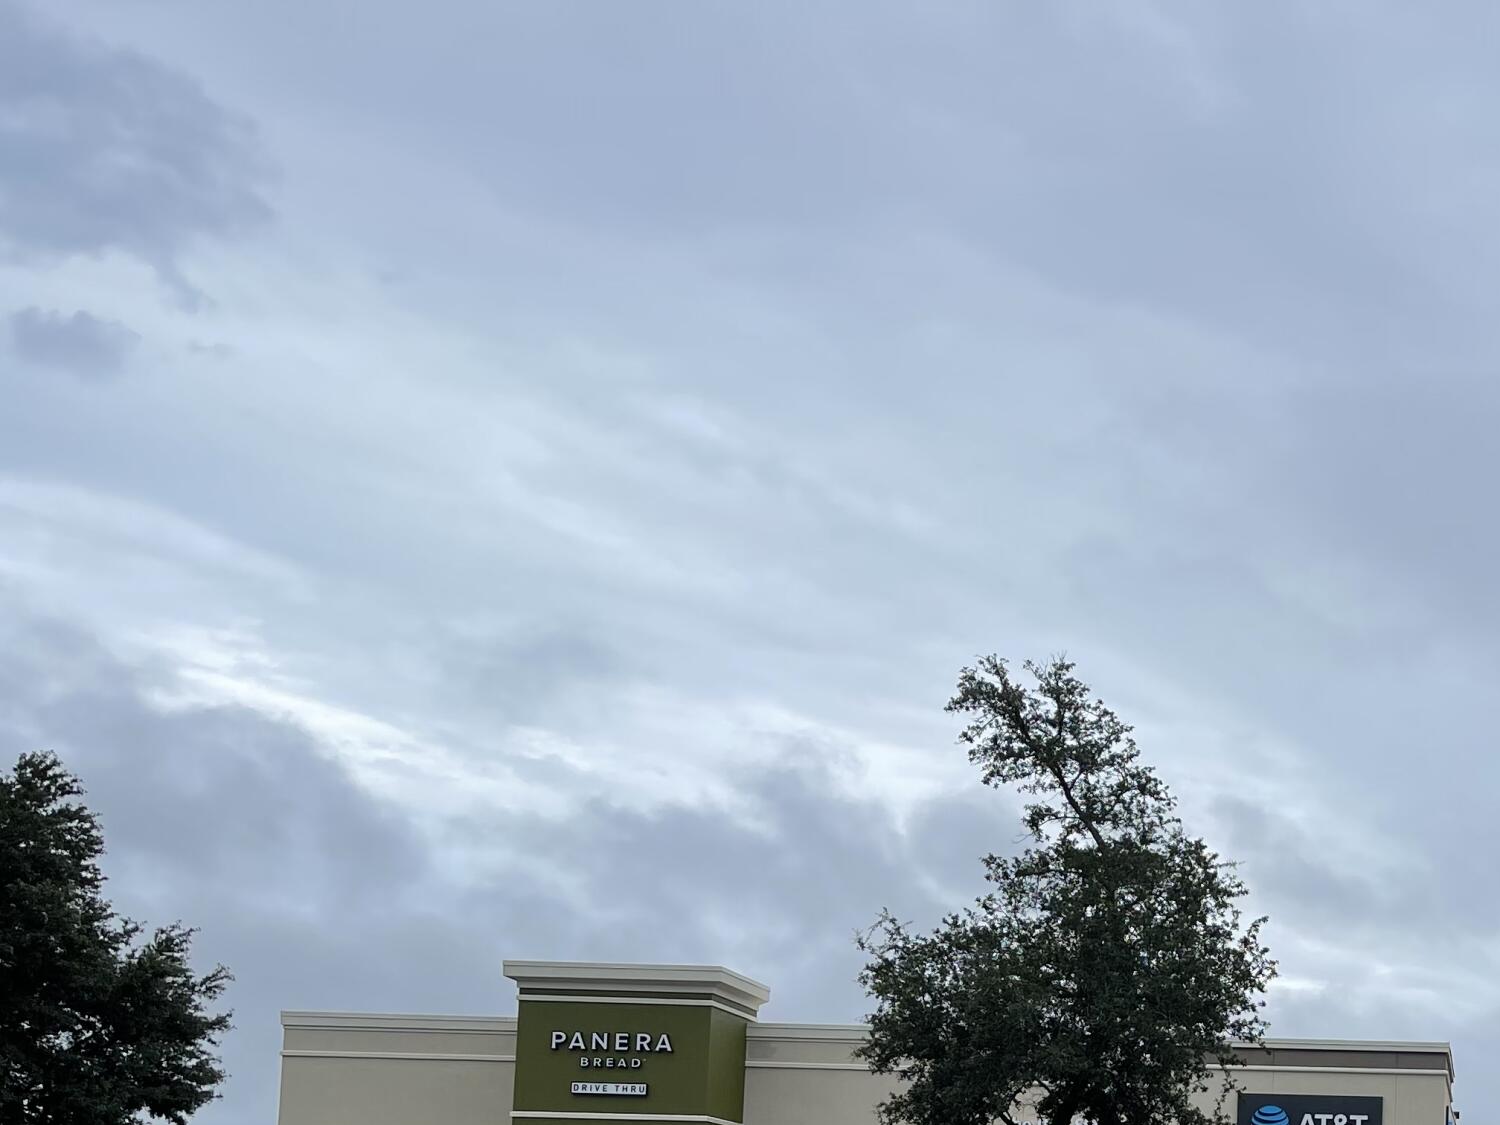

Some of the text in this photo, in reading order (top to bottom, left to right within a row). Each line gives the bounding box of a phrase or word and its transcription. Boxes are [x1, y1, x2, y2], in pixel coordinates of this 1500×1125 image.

[551, 1031, 673, 1052] PANERA
[580, 1057, 641, 1068] BREAD
[573, 1084, 645, 1093] DRIVE THRU
